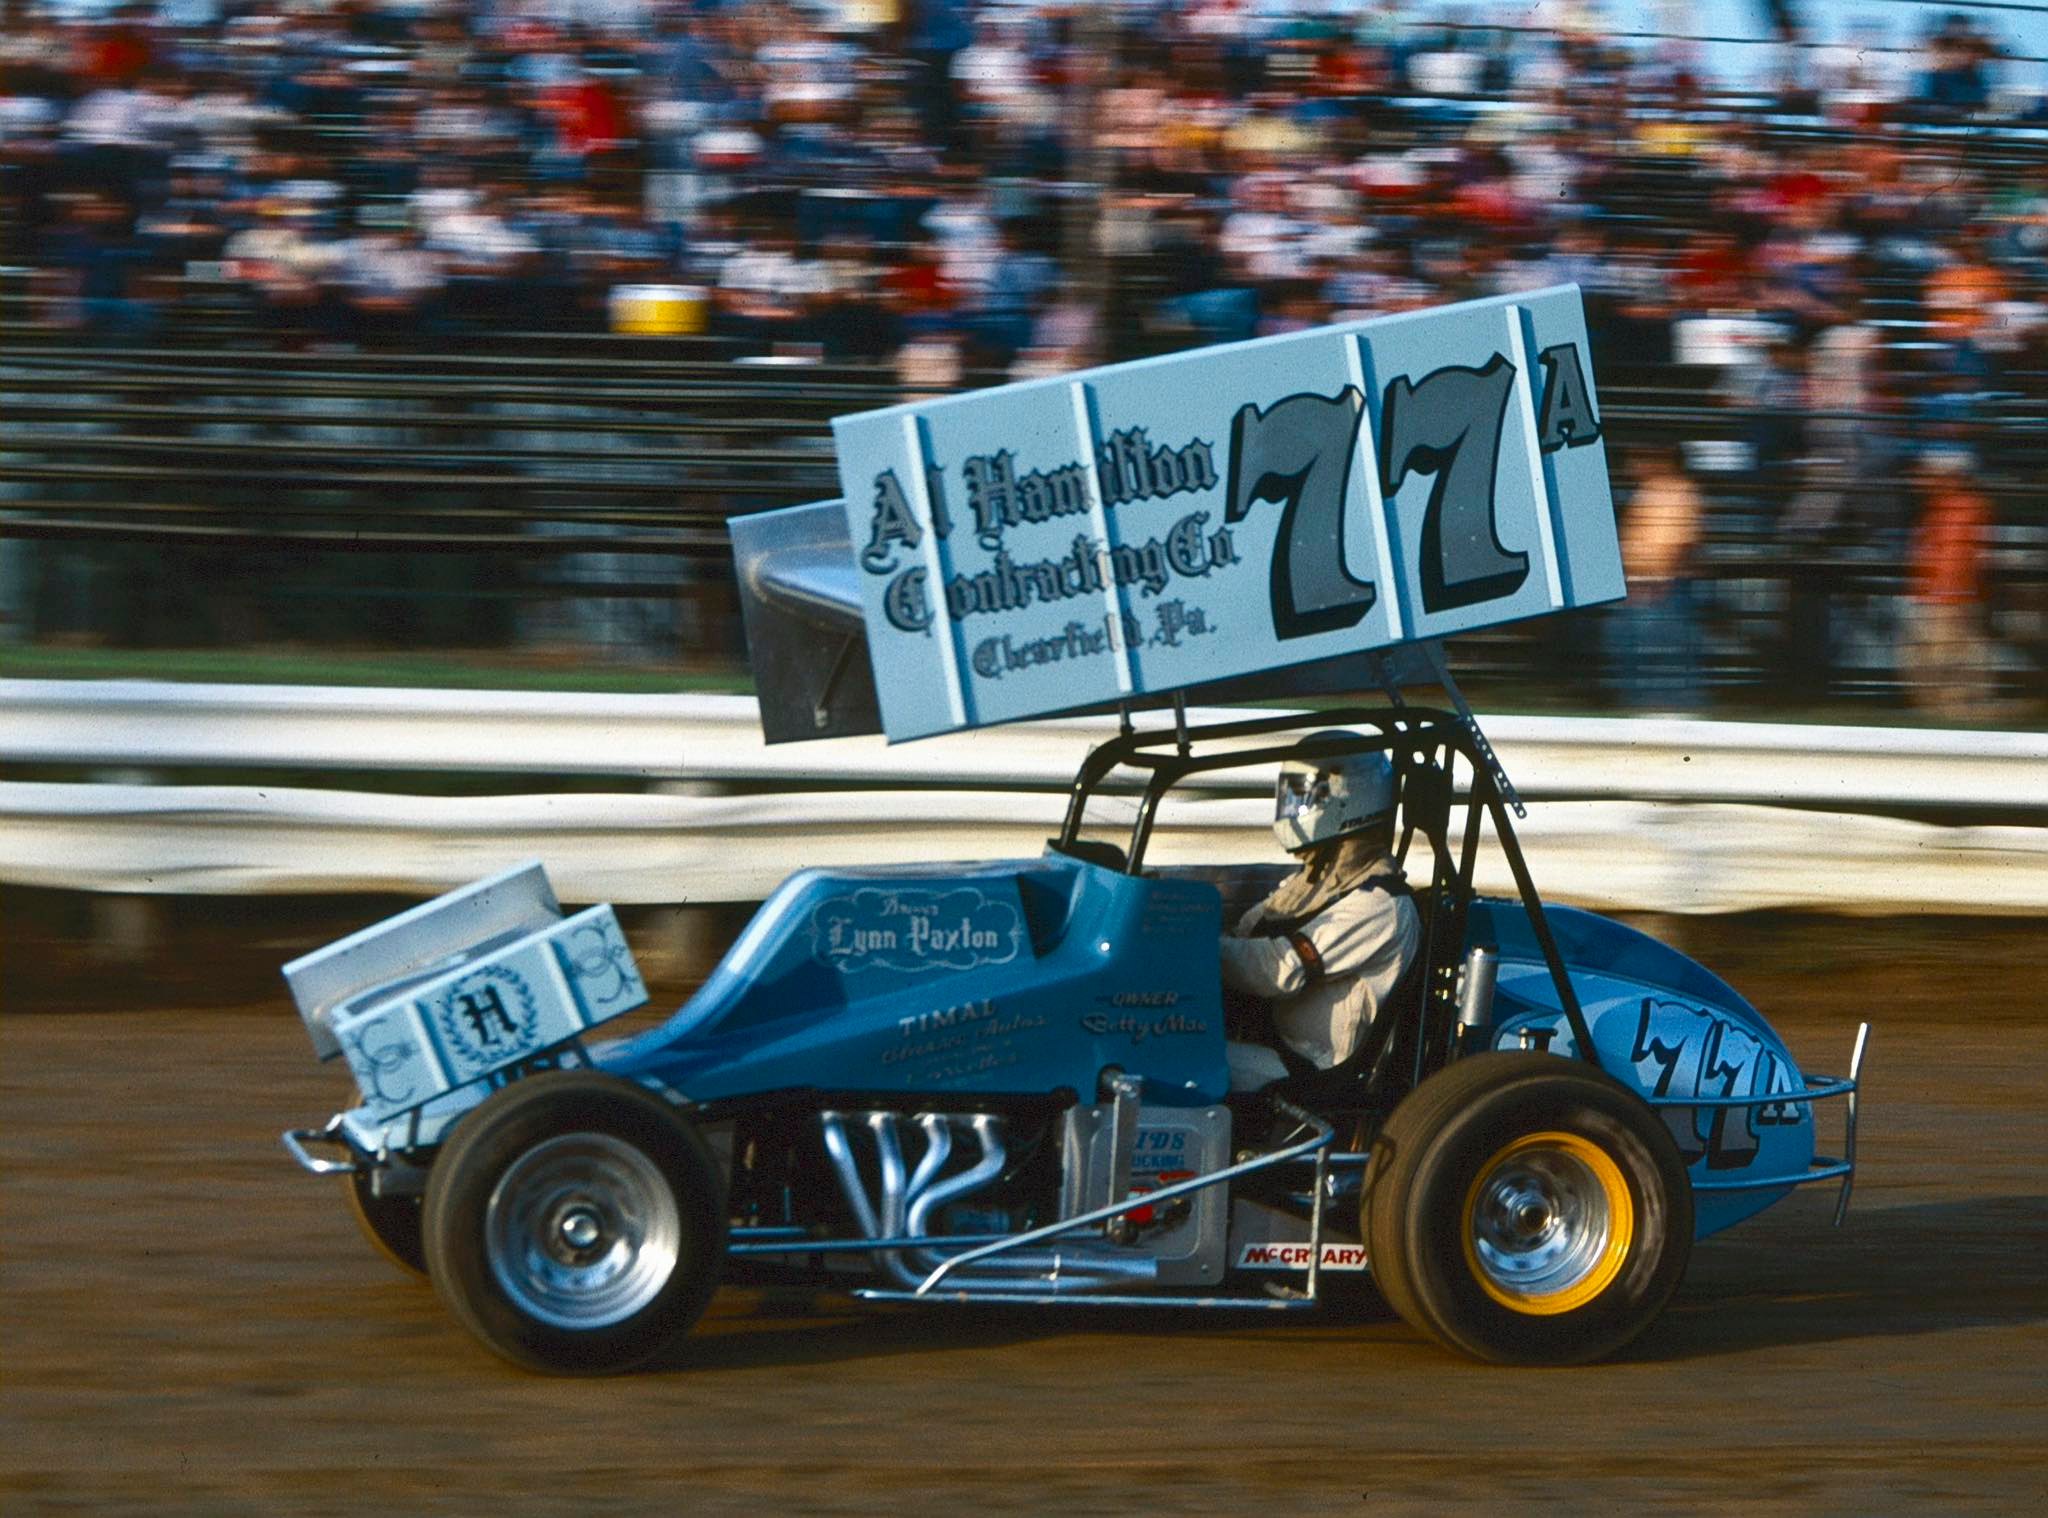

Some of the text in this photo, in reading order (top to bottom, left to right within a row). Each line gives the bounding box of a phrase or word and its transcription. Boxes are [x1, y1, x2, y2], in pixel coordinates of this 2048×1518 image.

[861, 426, 1220, 575] Al Hamilton
[1225, 350, 1530, 641] 77
[883, 532, 1169, 638] Contracting
[829, 915, 998, 956] Lynn Paxton
[457, 984, 517, 1046] H
